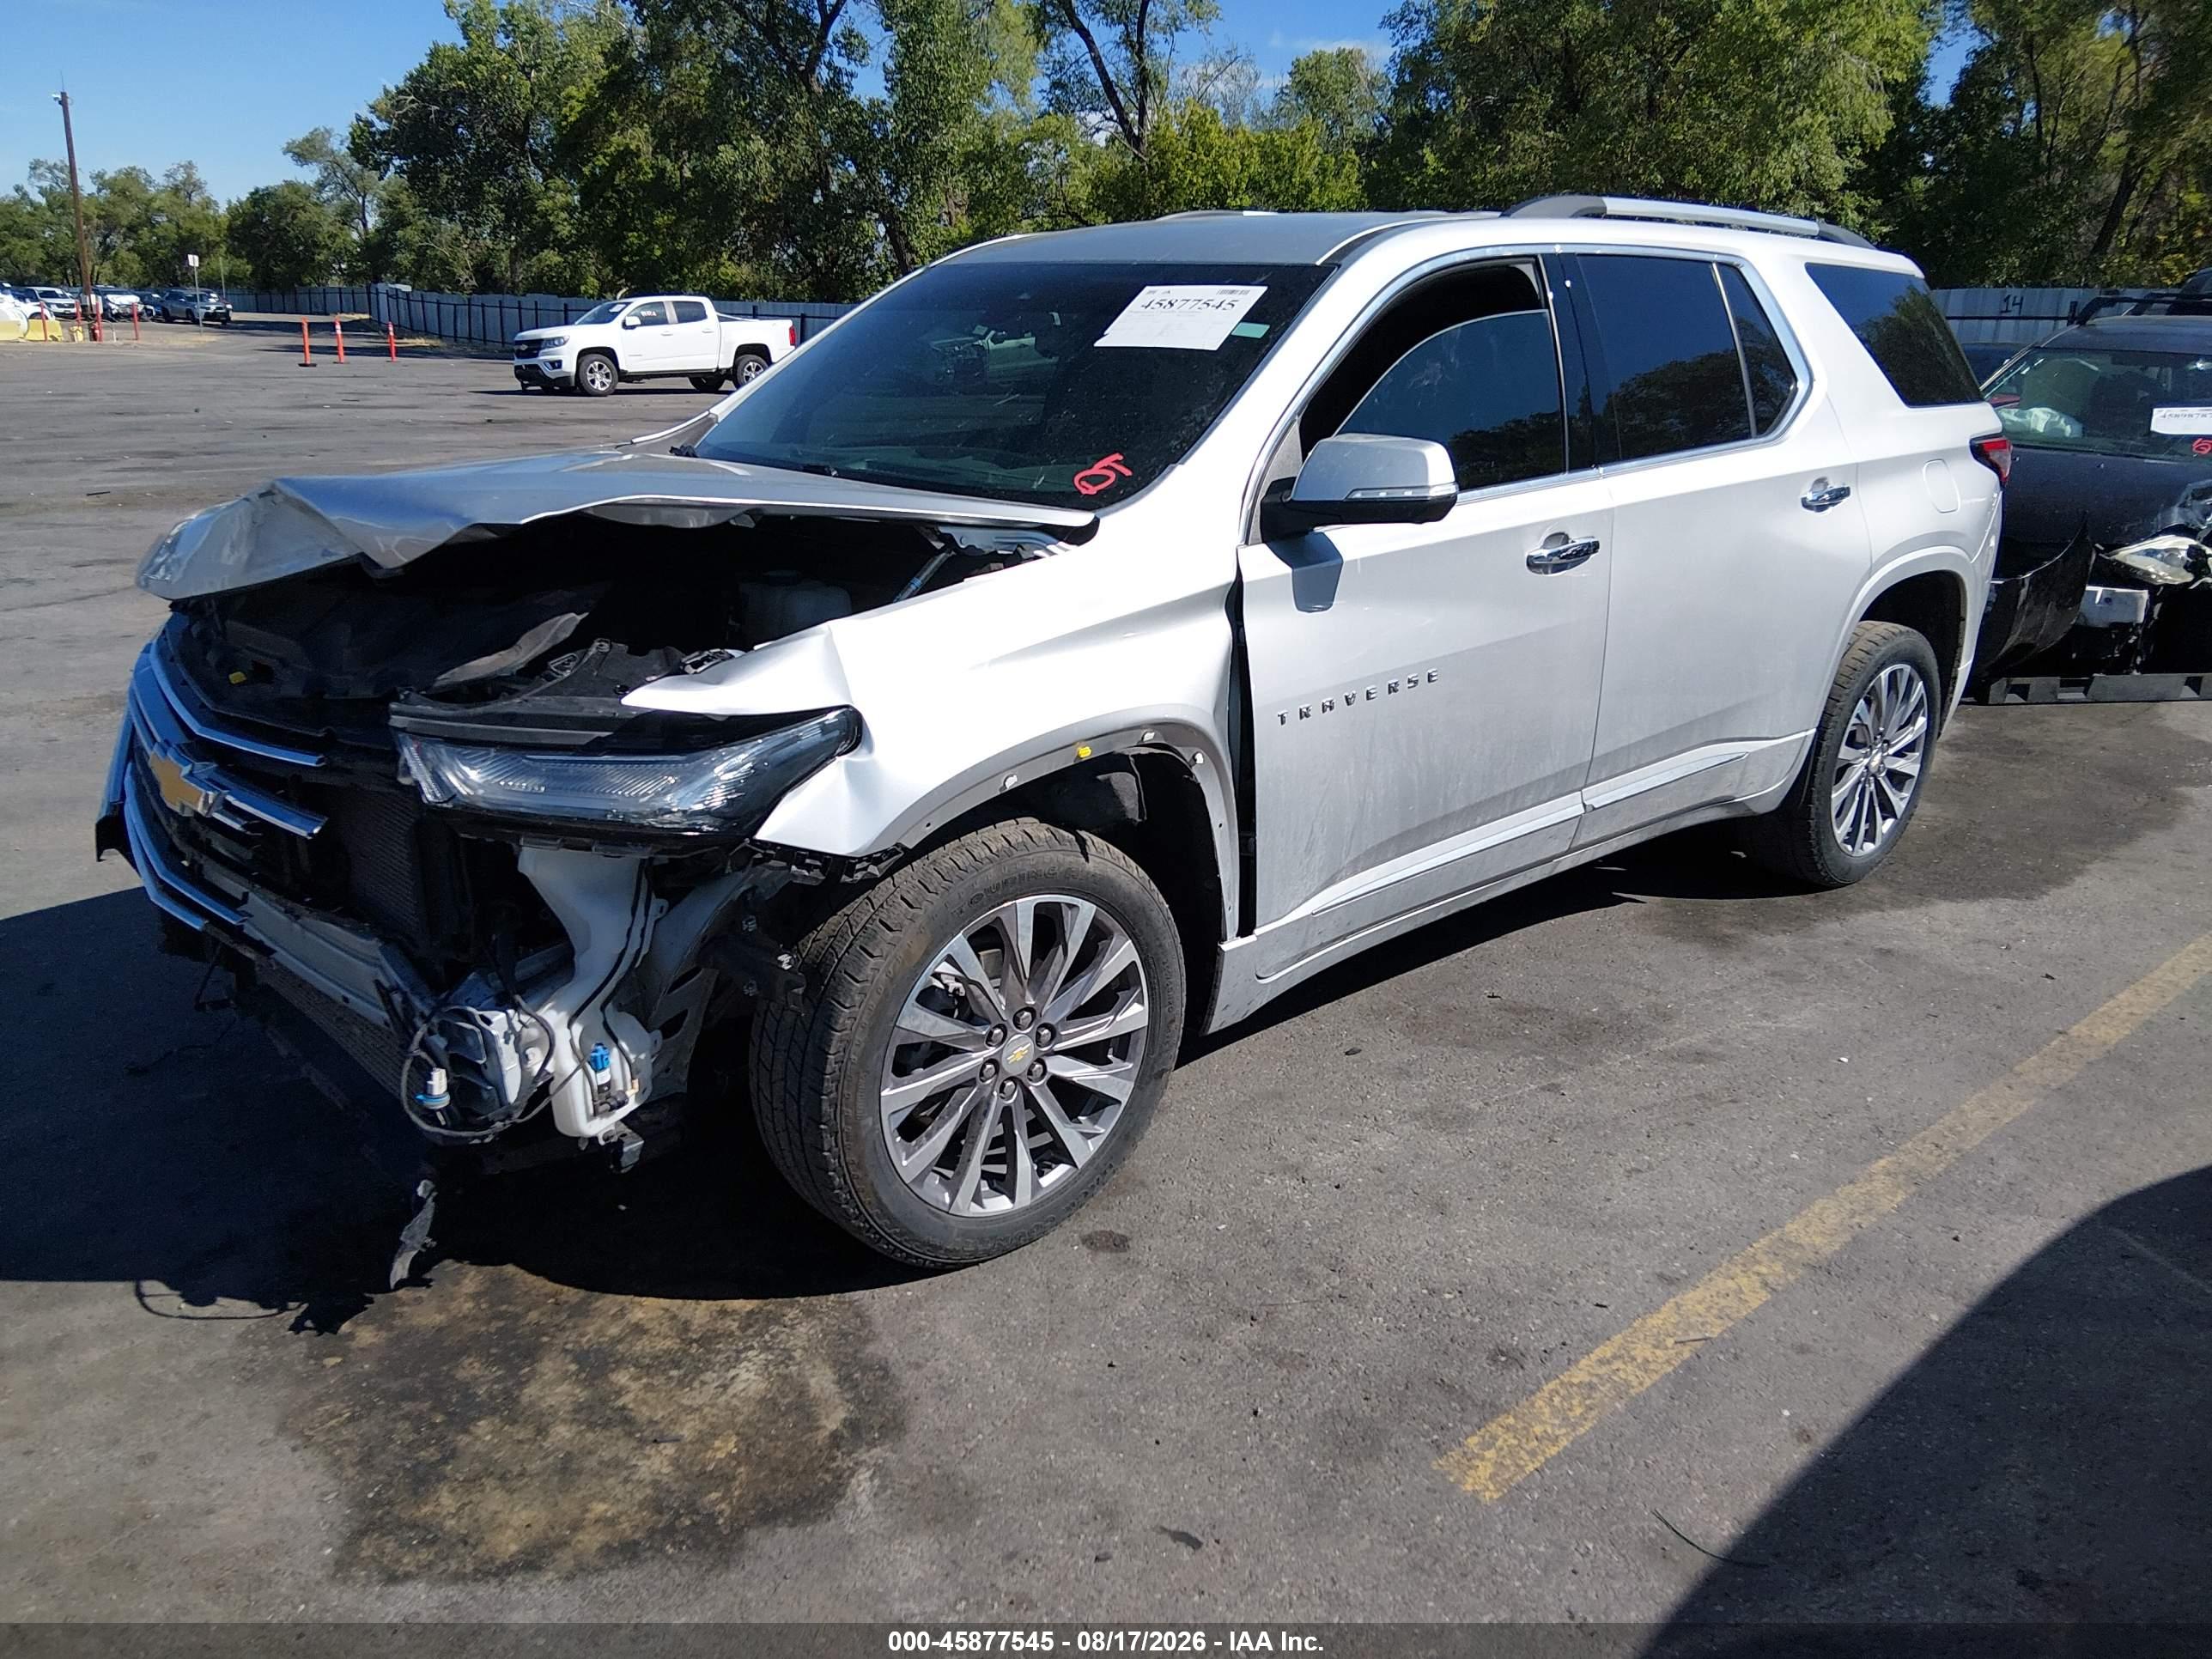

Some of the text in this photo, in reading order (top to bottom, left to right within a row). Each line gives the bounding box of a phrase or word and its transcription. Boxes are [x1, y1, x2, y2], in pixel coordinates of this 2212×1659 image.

[1140, 299, 1240, 311] 45877545
[2000, 295, 2024, 315] 14
[1278, 668, 1439, 726] TRAVERSE
